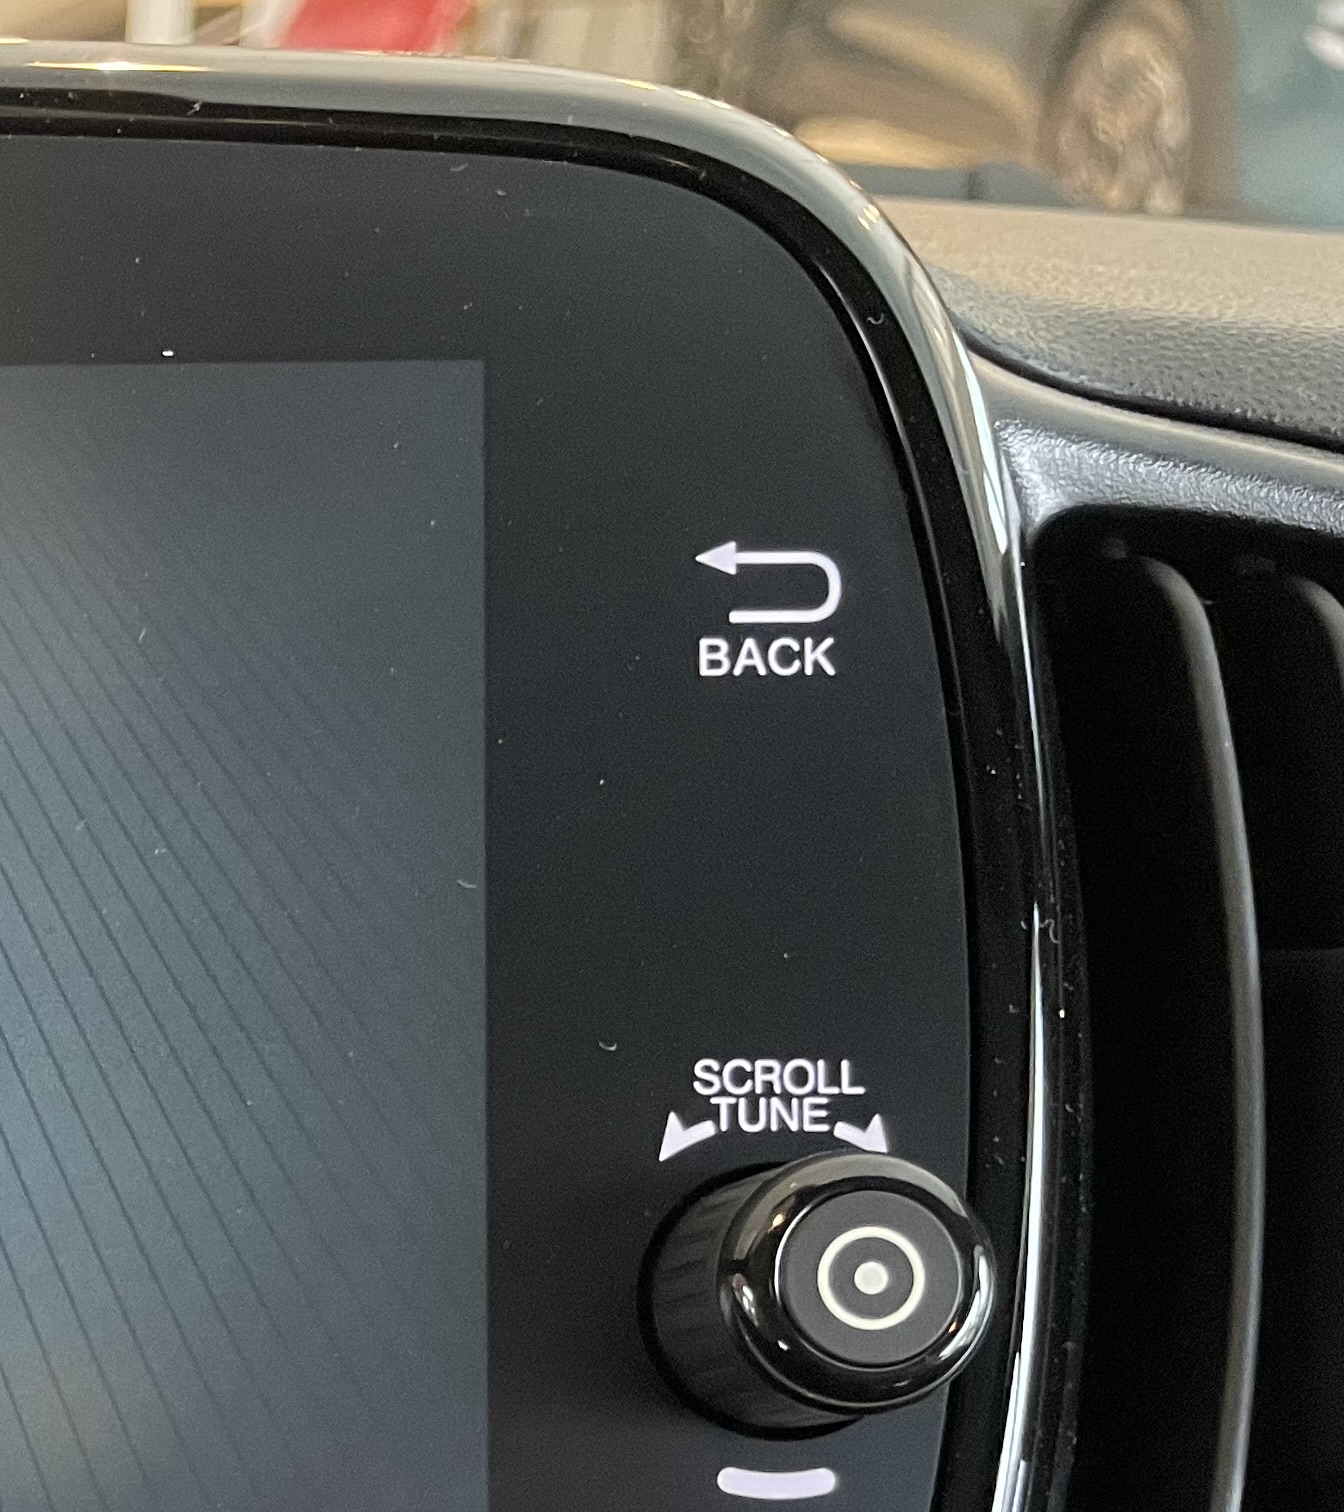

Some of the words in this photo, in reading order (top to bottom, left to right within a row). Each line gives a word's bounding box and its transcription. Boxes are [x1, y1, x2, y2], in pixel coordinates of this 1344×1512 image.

[697, 636, 837, 678] BACK
[693, 1059, 866, 1095] SCROLL
[709, 1096, 832, 1133] TUNE
